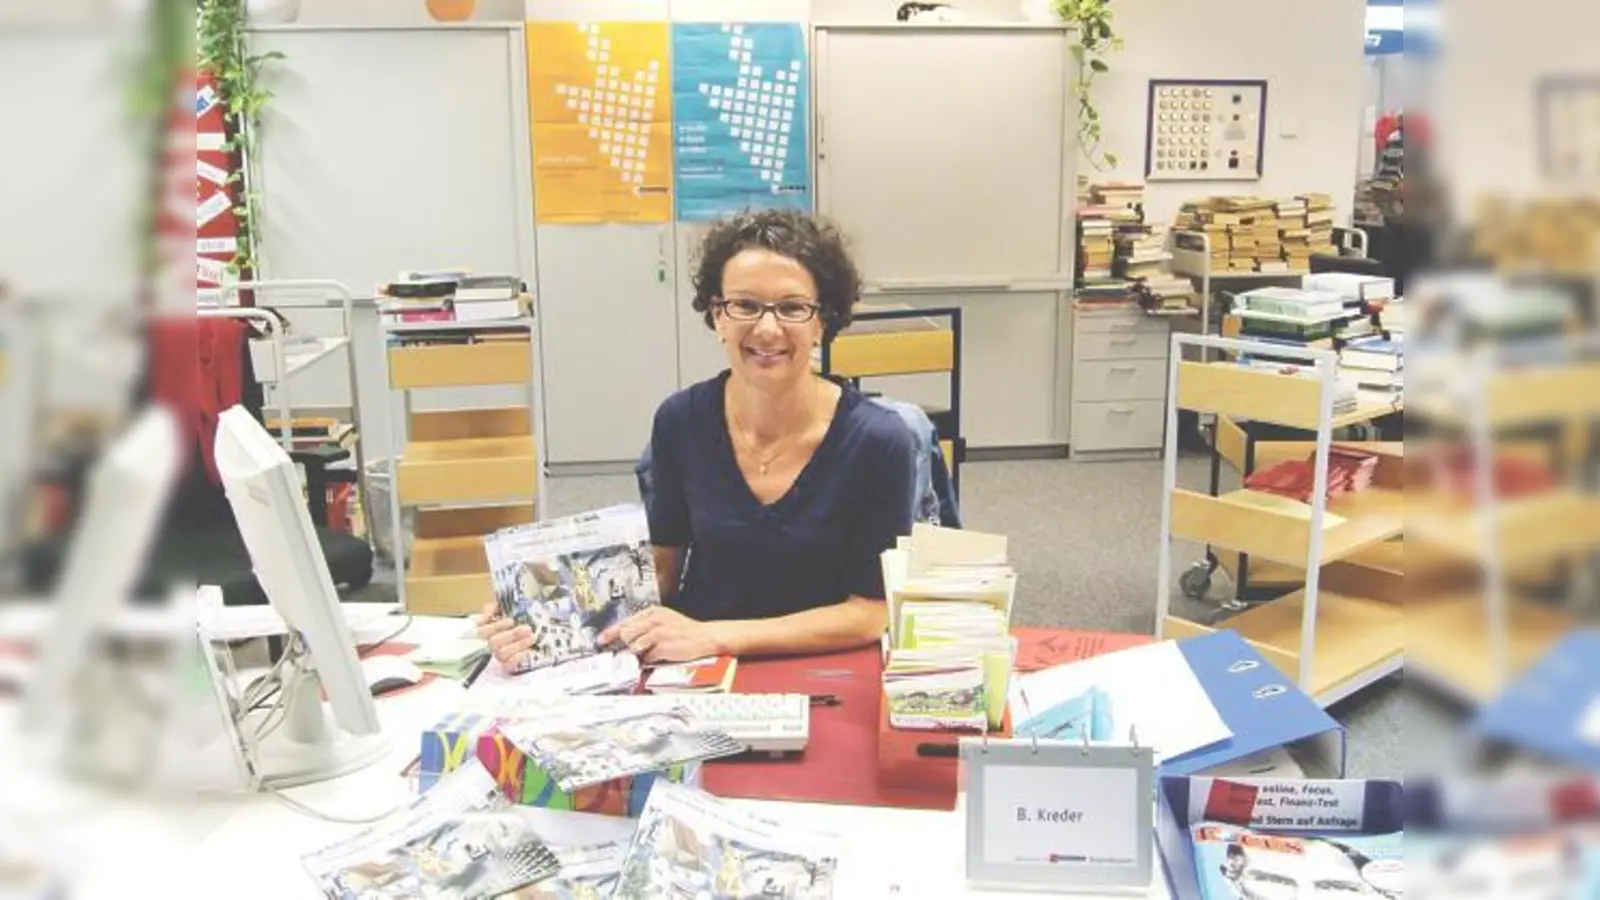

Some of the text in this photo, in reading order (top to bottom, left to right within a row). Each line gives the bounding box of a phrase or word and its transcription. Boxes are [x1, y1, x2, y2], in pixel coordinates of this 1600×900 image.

[1016, 806, 1084, 823] B. Kreder
[1266, 815, 1294, 826] Stern
[1296, 815, 1314, 826] auf
[1317, 815, 1358, 828] Anfrage
